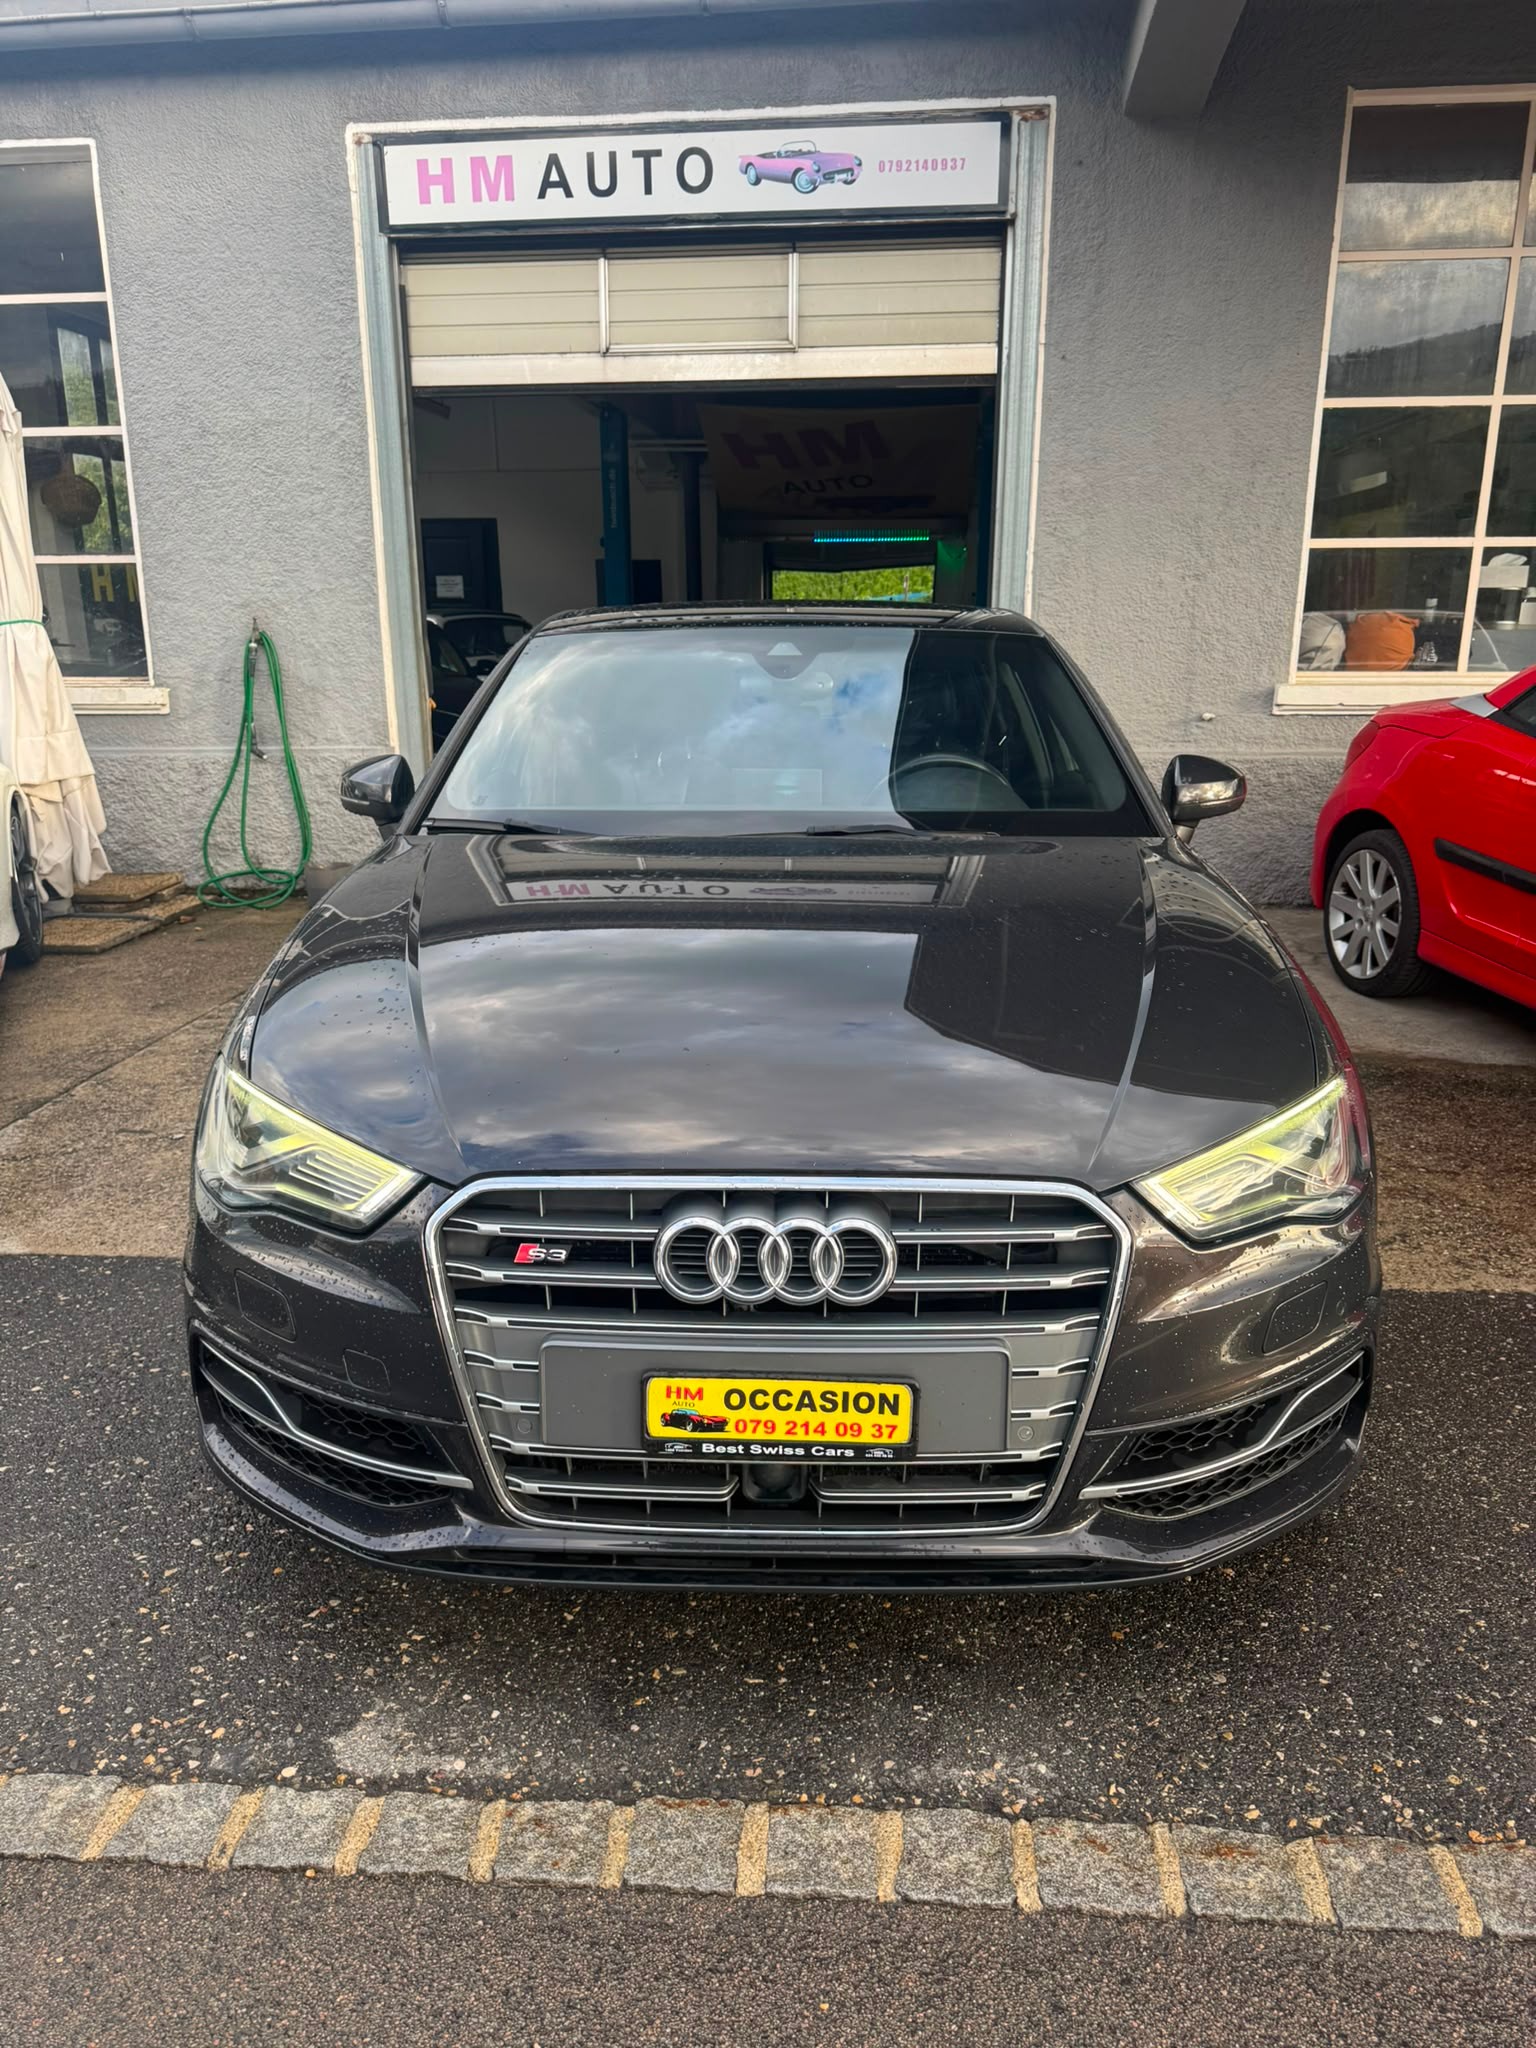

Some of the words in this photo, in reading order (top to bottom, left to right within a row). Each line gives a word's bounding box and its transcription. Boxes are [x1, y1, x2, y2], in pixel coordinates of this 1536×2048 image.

[878, 157, 967, 173] 0792140937
[416, 154, 516, 205] HM
[537, 146, 714, 200] AUTO
[721, 419, 893, 470] HM
[784, 474, 873, 495] AUTO
[527, 1248, 567, 1261] S3
[666, 1384, 704, 1401] HM
[672, 1400, 695, 1408] AUTO
[723, 1388, 900, 1416] OCCASION
[734, 1419, 776, 1435] 079
[784, 1420, 827, 1437] 214
[835, 1422, 862, 1438] 09
[871, 1424, 898, 1439] 37
[701, 1443, 744, 1454] Best
[750, 1444, 808, 1456] Swiss
[811, 1445, 855, 1457] Cars
